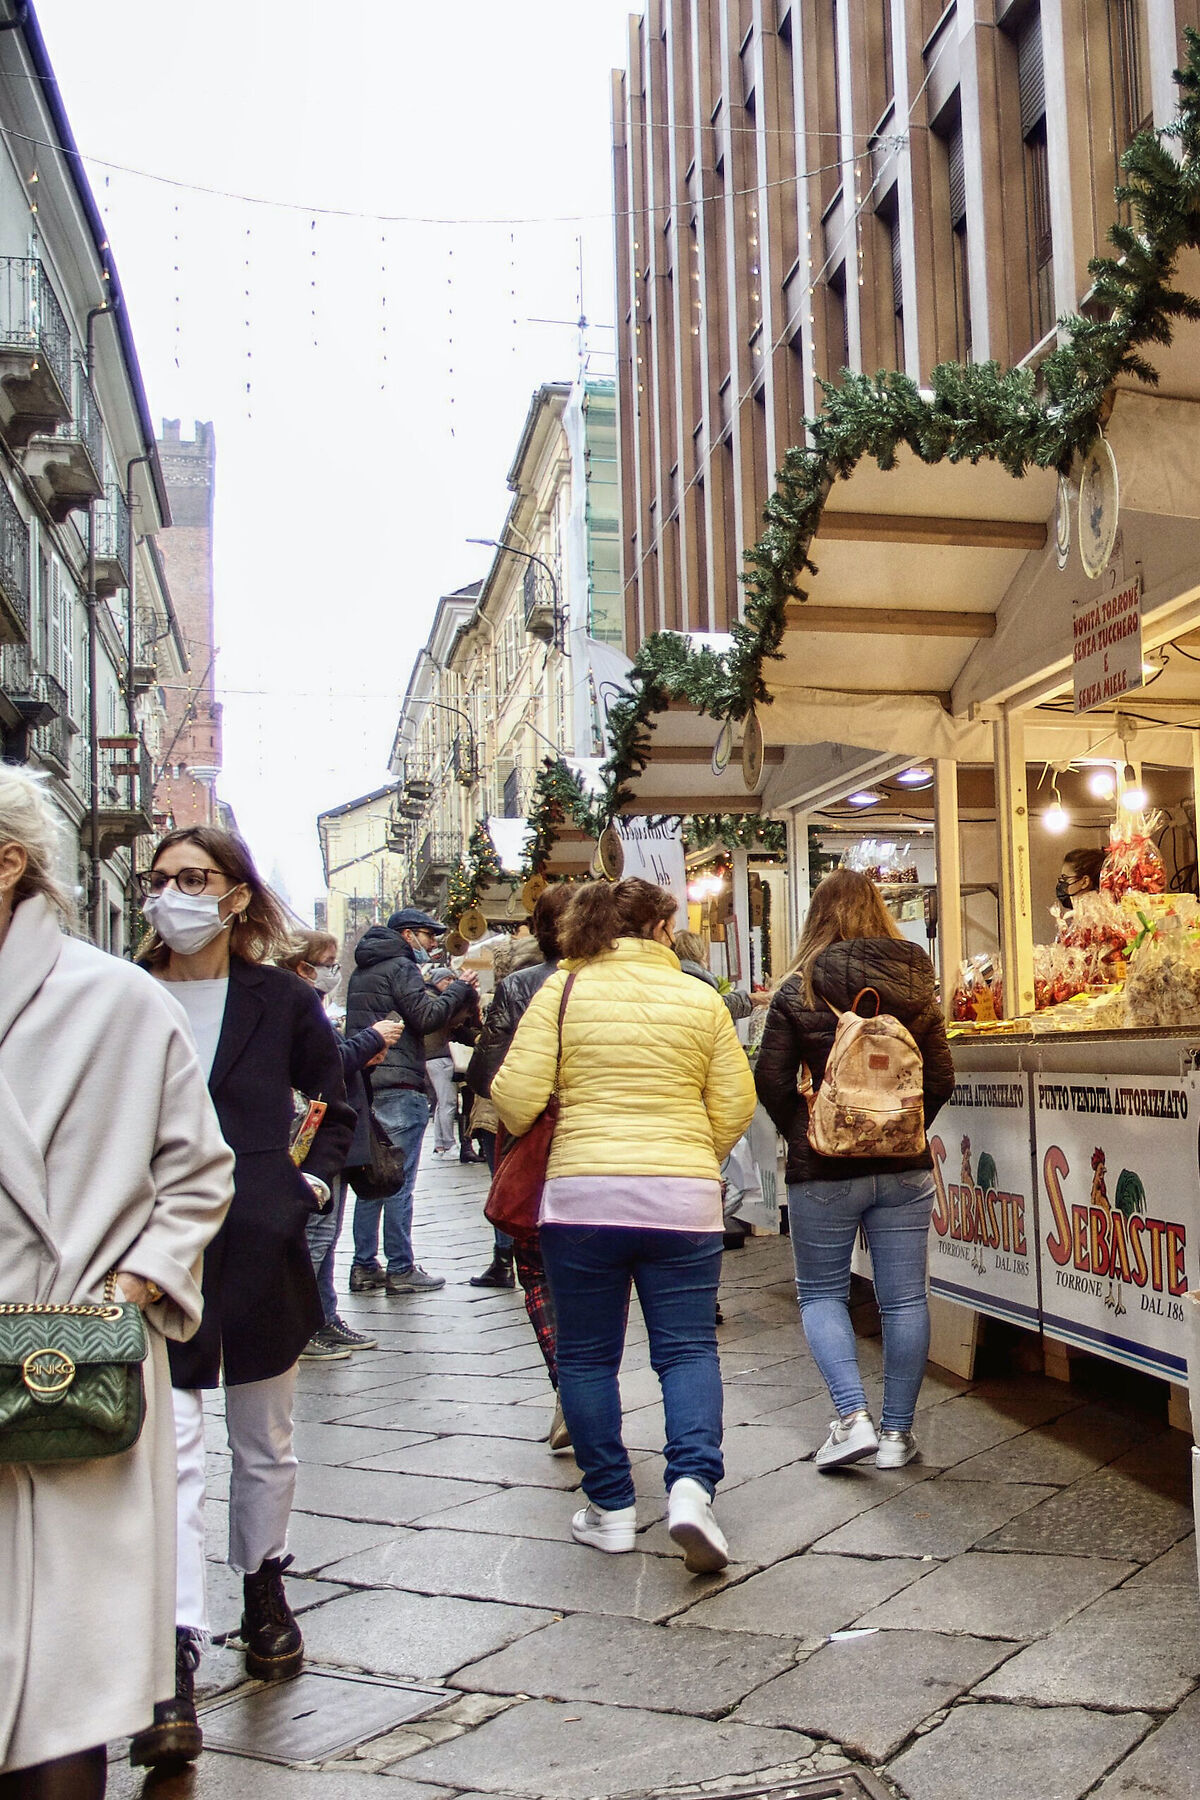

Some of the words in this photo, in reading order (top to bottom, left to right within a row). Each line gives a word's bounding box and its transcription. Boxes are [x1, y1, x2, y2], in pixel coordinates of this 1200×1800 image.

[1073, 600, 1101, 639] NOVITÀ
[1101, 583, 1139, 624] TORRONE
[1073, 632, 1097, 664] SENZA
[1098, 611, 1139, 651] ZUCCHERO
[1104, 651, 1109, 673] E
[1078, 681, 1102, 711] SENZA
[1103, 668, 1127, 698] MIELE
[974, 1083, 1024, 1108] AUTORIZZATO
[1038, 1084, 1069, 1111] PUNTO
[1069, 1085, 1113, 1114] VENDITA
[1114, 1087, 1188, 1120] AUTORIZZATO
[930, 1134, 1028, 1257] SEBASTE
[1043, 1145, 1190, 1298] SEBASTE
[937, 1239, 971, 1262] TORRONE
[994, 1253, 1012, 1273] DAL
[1012, 1257, 1030, 1277] 1885
[1055, 1269, 1103, 1298] TORRONE
[1140, 1293, 1165, 1318] DAL
[1166, 1300, 1185, 1322] 188
[24, 1362, 76, 1376] PINKO
